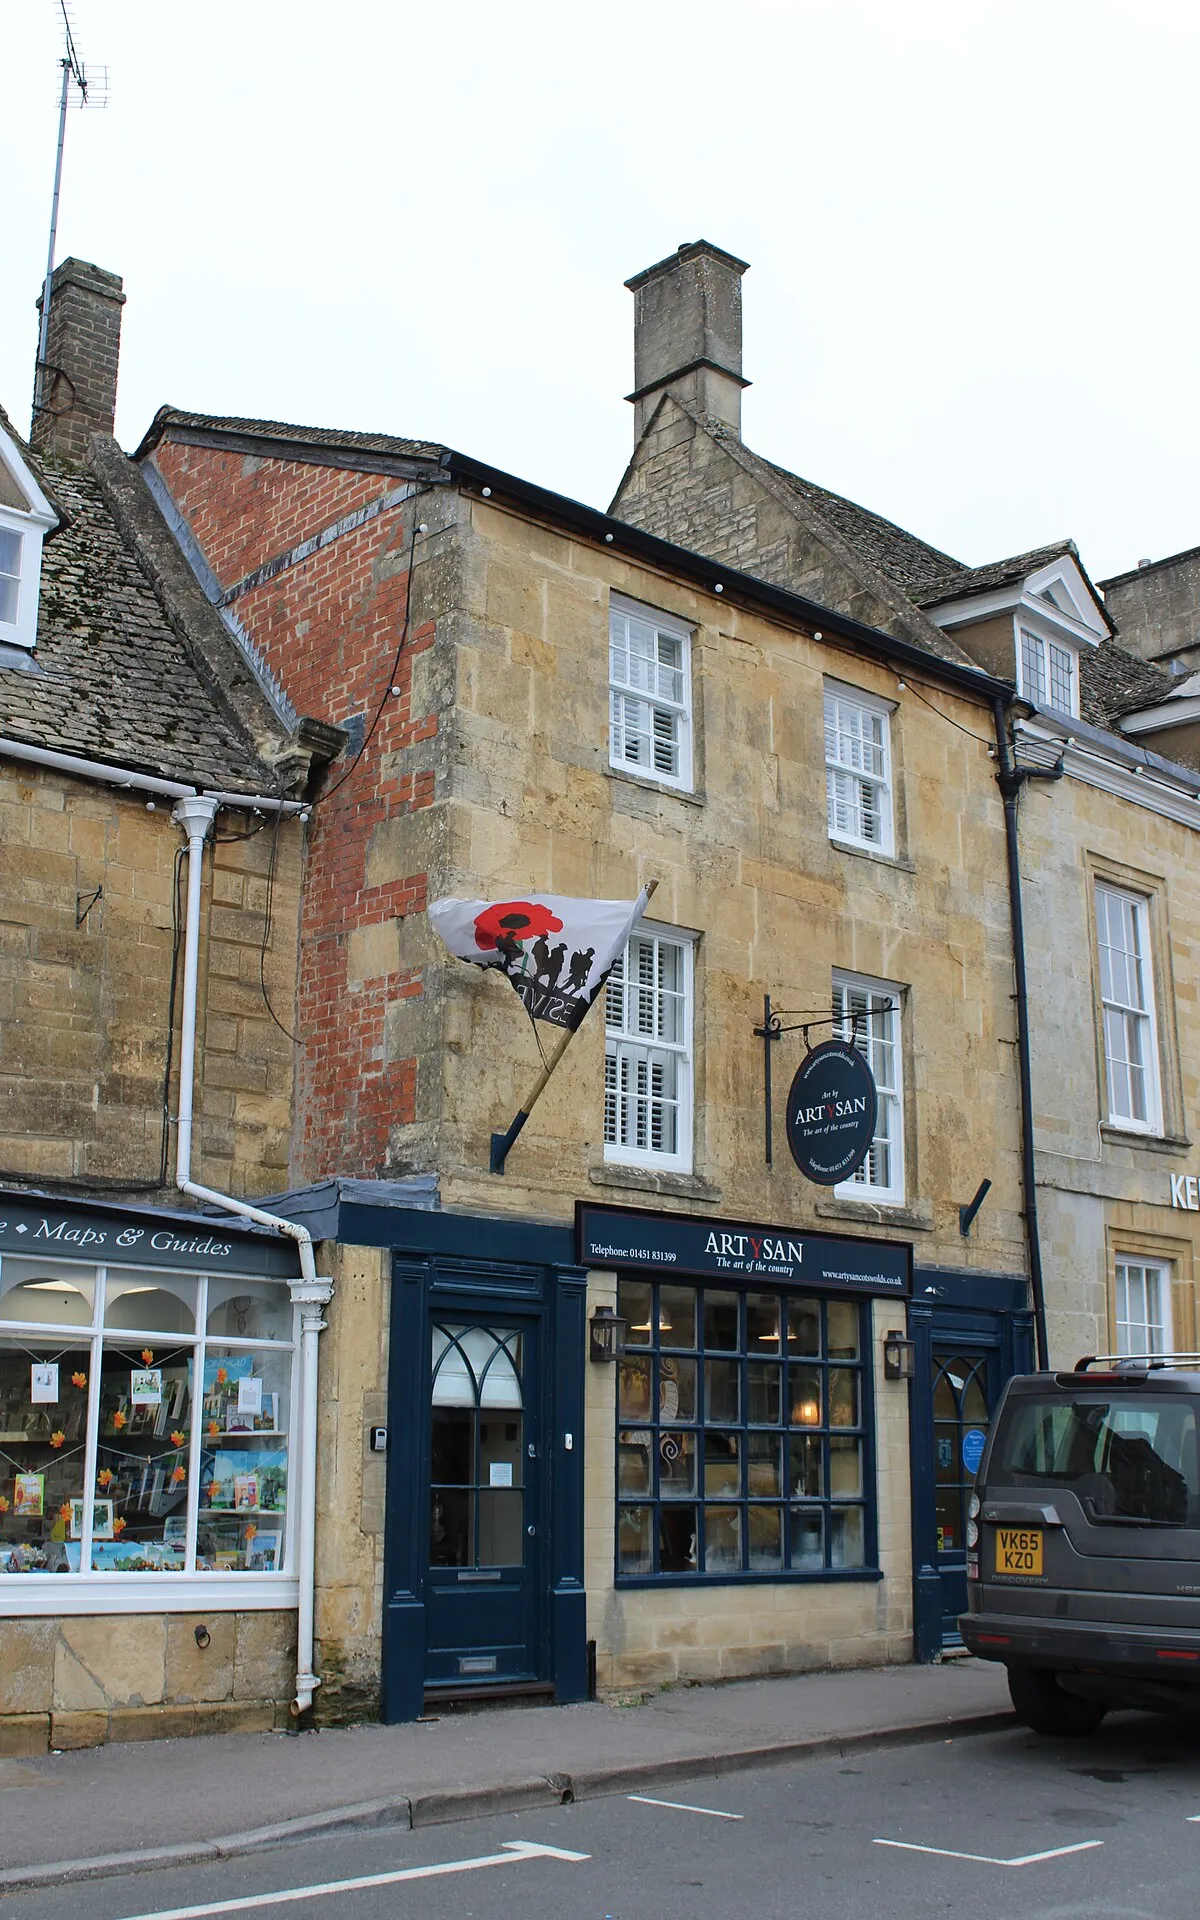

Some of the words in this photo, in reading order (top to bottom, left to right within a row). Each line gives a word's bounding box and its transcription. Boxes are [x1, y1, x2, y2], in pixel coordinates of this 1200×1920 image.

[821, 1091, 831, 1099] Art
[832, 1090, 839, 1098] by
[795, 1097, 866, 1125] ARTYSAN
[803, 1129, 814, 1137] The
[823, 1125, 830, 1134] of
[830, 1124, 839, 1132] the
[839, 1120, 859, 1130] country
[1170, 1173, 1200, 1211] KE
[33, 1218, 107, 1247] Maps
[115, 1228, 145, 1247] &
[150, 1231, 232, 1256] Guides
[590, 1243, 629, 1258] Telephone:
[629, 1248, 650, 1260] 01451
[651, 1250, 677, 1263] 831399
[704, 1231, 804, 1264] ARTYSAN
[716, 1256, 731, 1267] The
[733, 1260, 744, 1269] art
[746, 1260, 755, 1272] of
[755, 1260, 767, 1272] the
[768, 1264, 794, 1277] country
[822, 1270, 903, 1286] www.artysancotswolds.co.uk
[1000, 1531, 1039, 1551] VK65
[1004, 1551, 1034, 1569] KZO
[992, 1574, 1049, 1585] DISCOVERY
